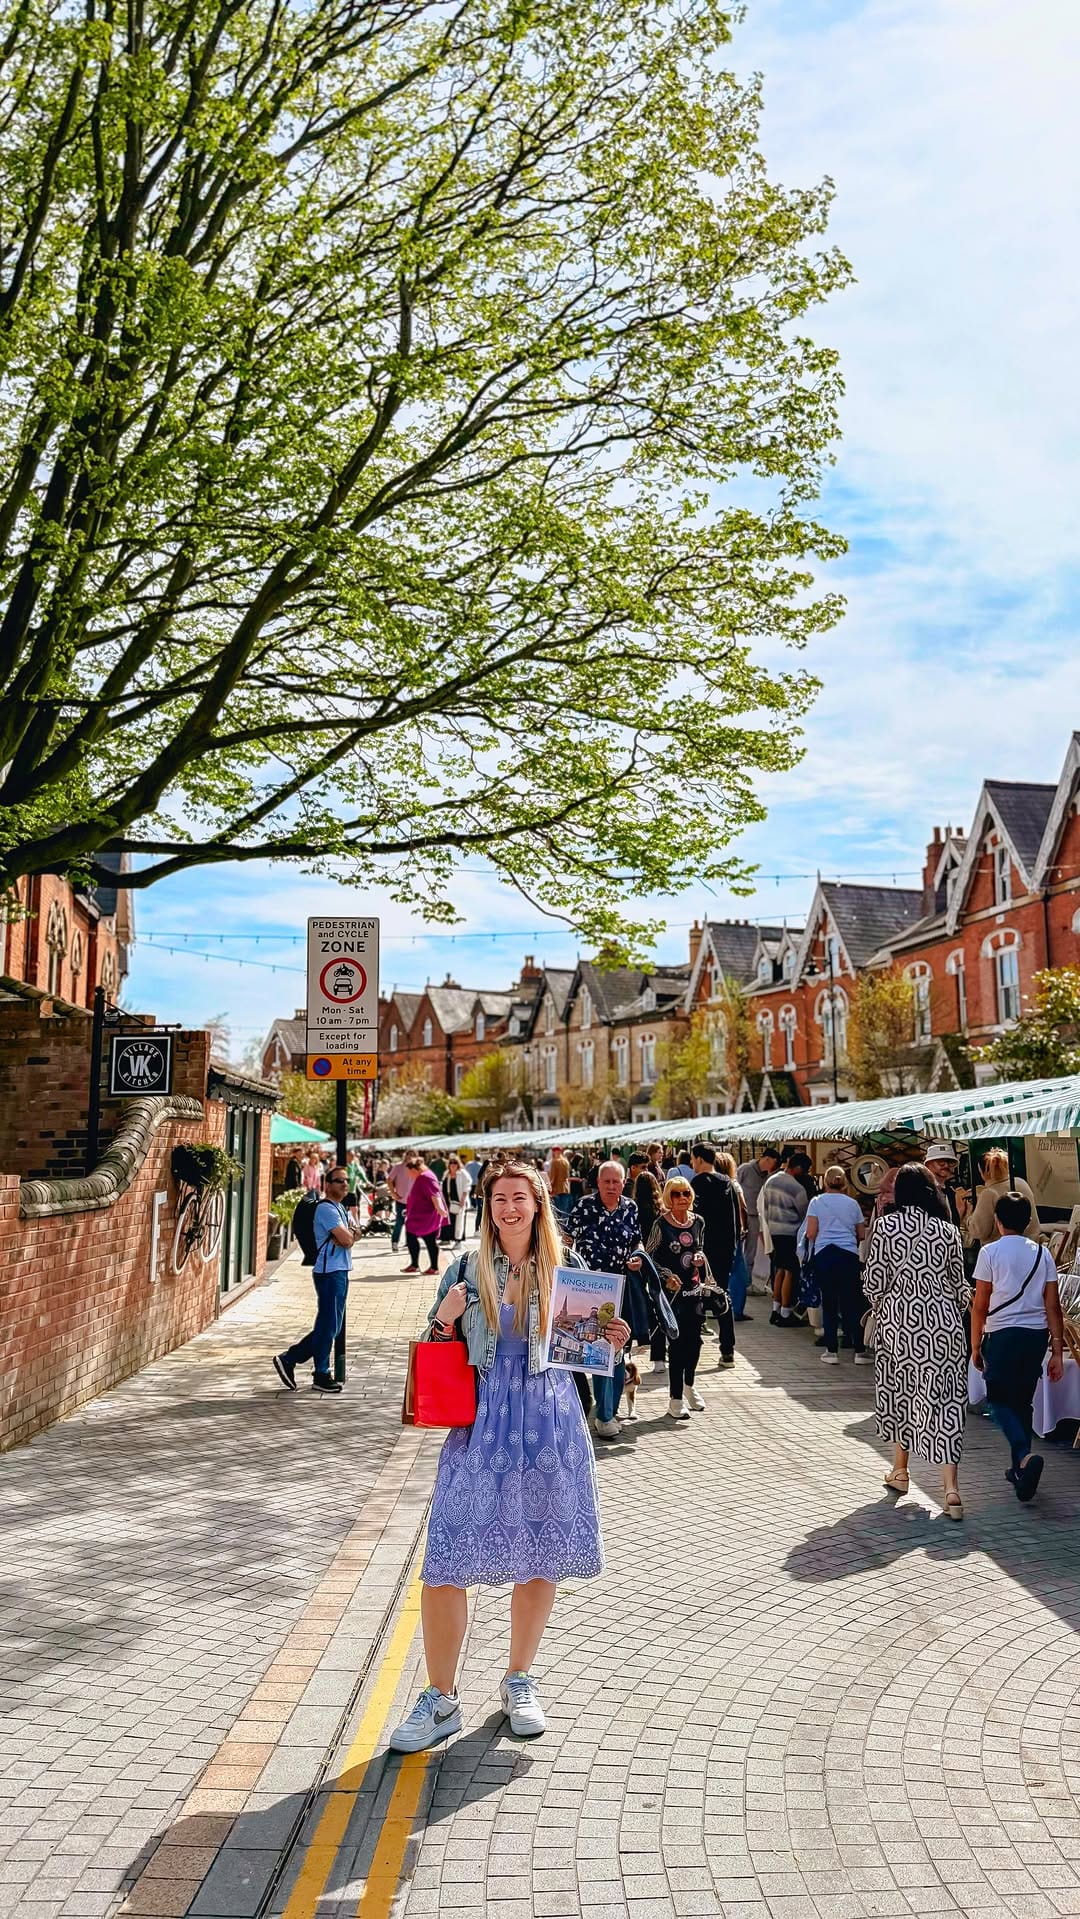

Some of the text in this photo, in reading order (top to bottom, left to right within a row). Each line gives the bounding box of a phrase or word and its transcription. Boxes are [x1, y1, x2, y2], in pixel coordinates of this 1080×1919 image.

[312, 921, 375, 929] PEDESTRIAN
[321, 941, 366, 953] ZONE
[322, 1006, 342, 1014] Mon
[349, 1006, 364, 1014] Sat
[319, 1032, 366, 1041] Except for
[123, 1044, 160, 1058] VILLAGE
[326, 1042, 359, 1050] loading
[129, 1055, 151, 1076] VK
[342, 1057, 372, 1067] At any
[347, 1066, 367, 1075] time
[122, 1071, 159, 1086] KITCHEN
[561, 1278, 613, 1291] KINGS HEATH
